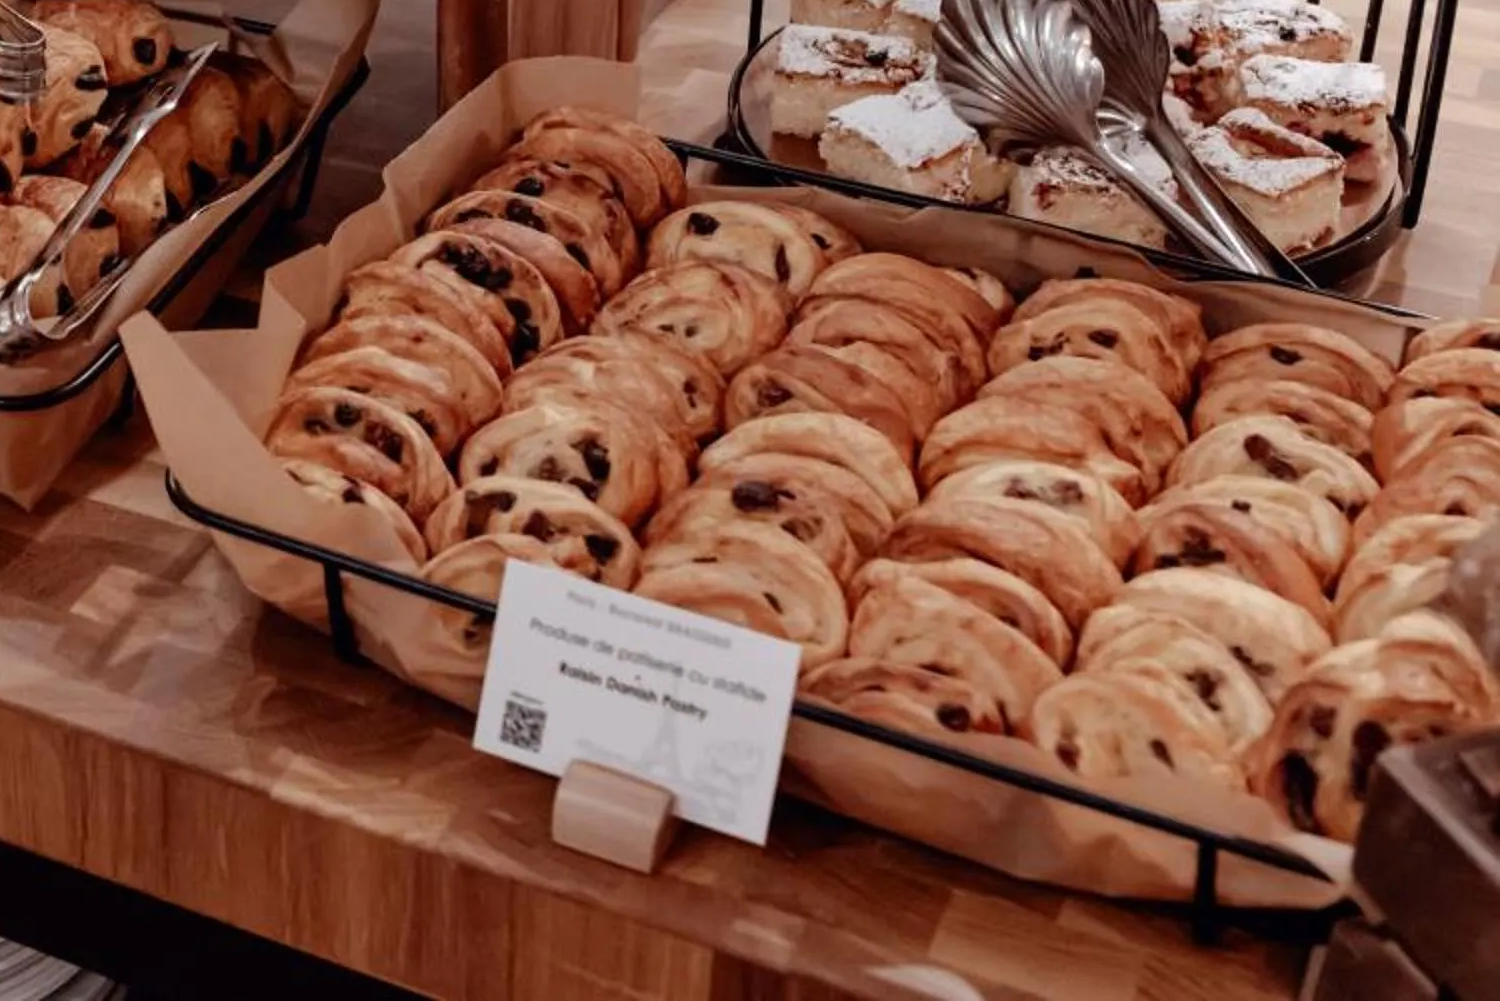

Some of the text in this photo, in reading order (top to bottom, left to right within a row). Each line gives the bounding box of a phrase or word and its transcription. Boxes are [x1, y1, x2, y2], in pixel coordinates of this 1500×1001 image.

[529, 617, 590, 648] Produse
[592, 639, 615, 655] de
[687, 668, 709, 685] cu
[559, 661, 708, 721] Raisin Danish Pastry
